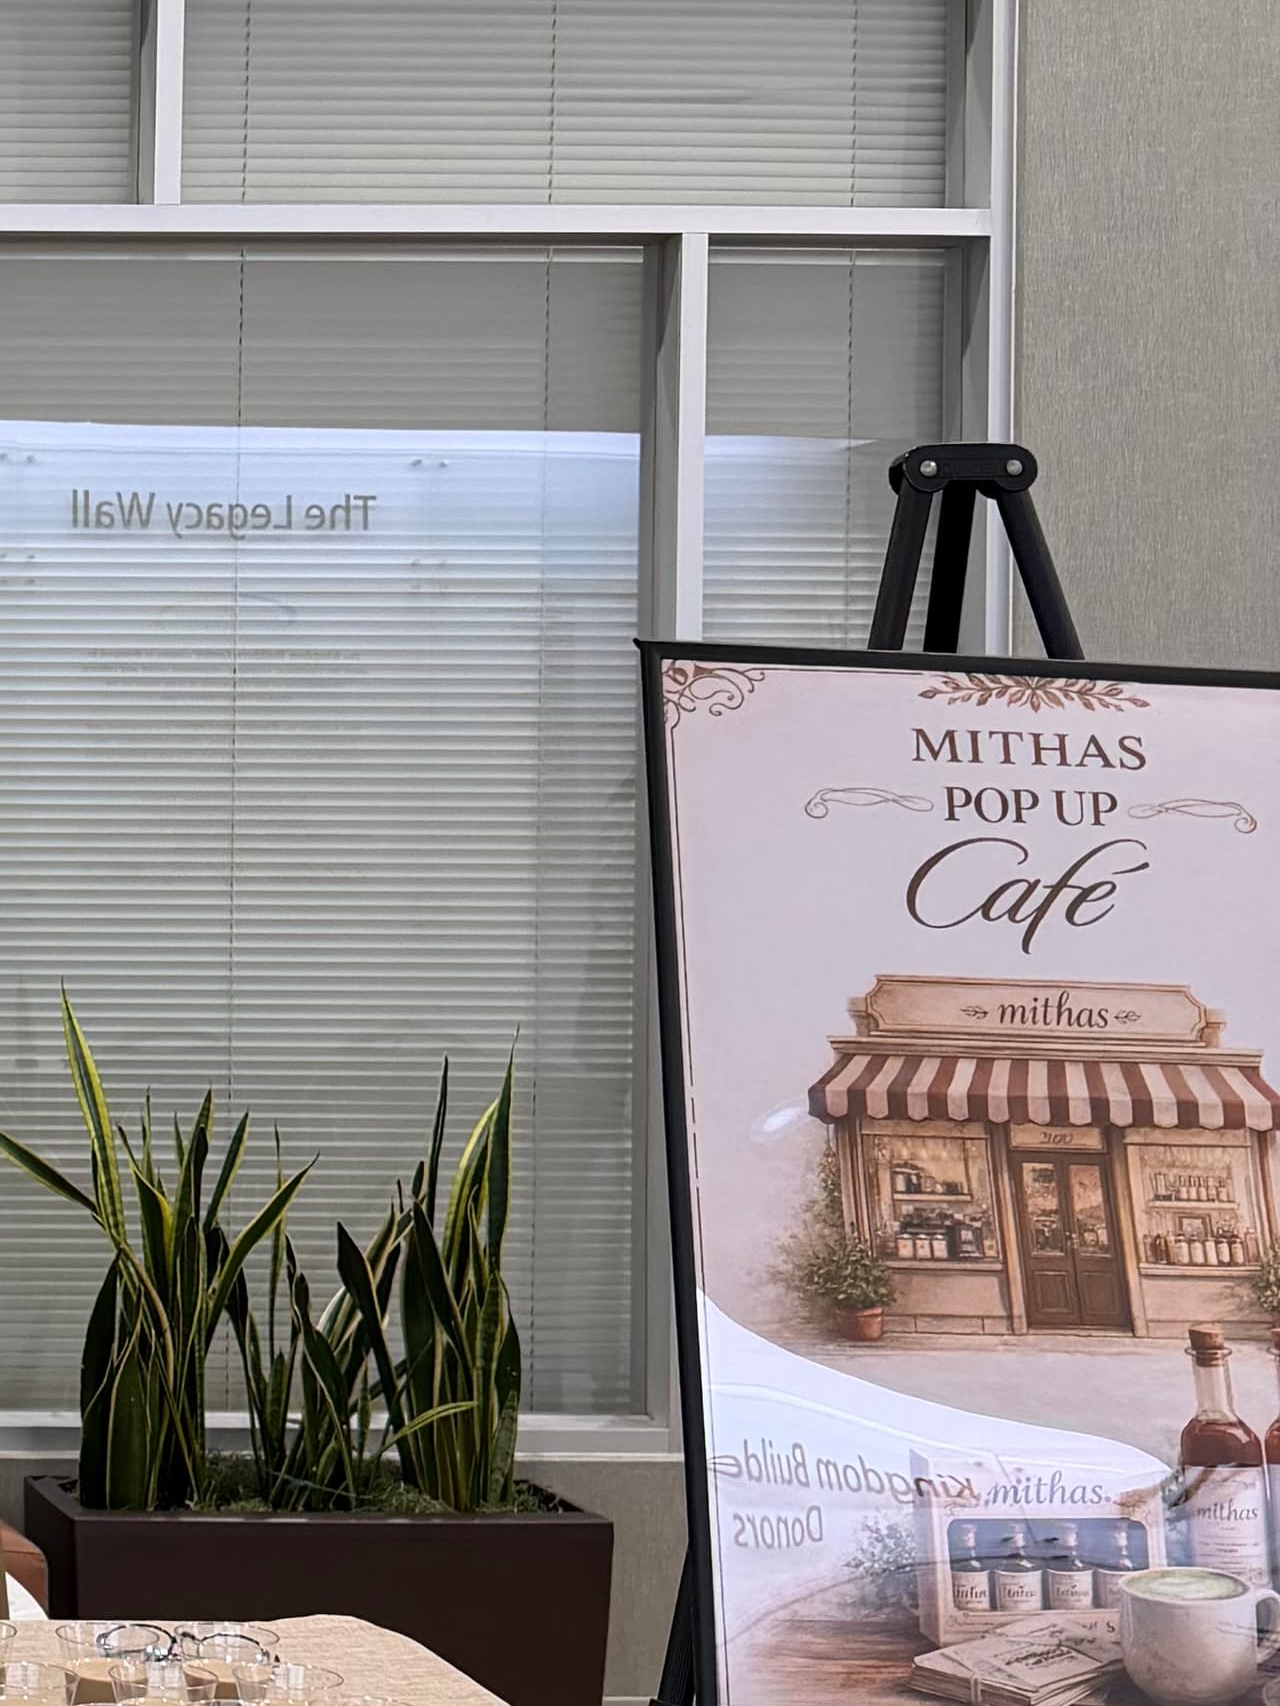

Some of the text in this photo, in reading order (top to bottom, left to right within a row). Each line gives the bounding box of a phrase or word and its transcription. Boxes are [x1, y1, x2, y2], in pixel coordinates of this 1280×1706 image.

[910, 727, 1148, 771] MITHAS
[943, 785, 1119, 827] POP UP
[905, 836, 1151, 955] Café
[998, 989, 1110, 1029] mithas
[989, 1469, 1104, 1508] mithas
[1196, 1497, 1260, 1522] mithas
